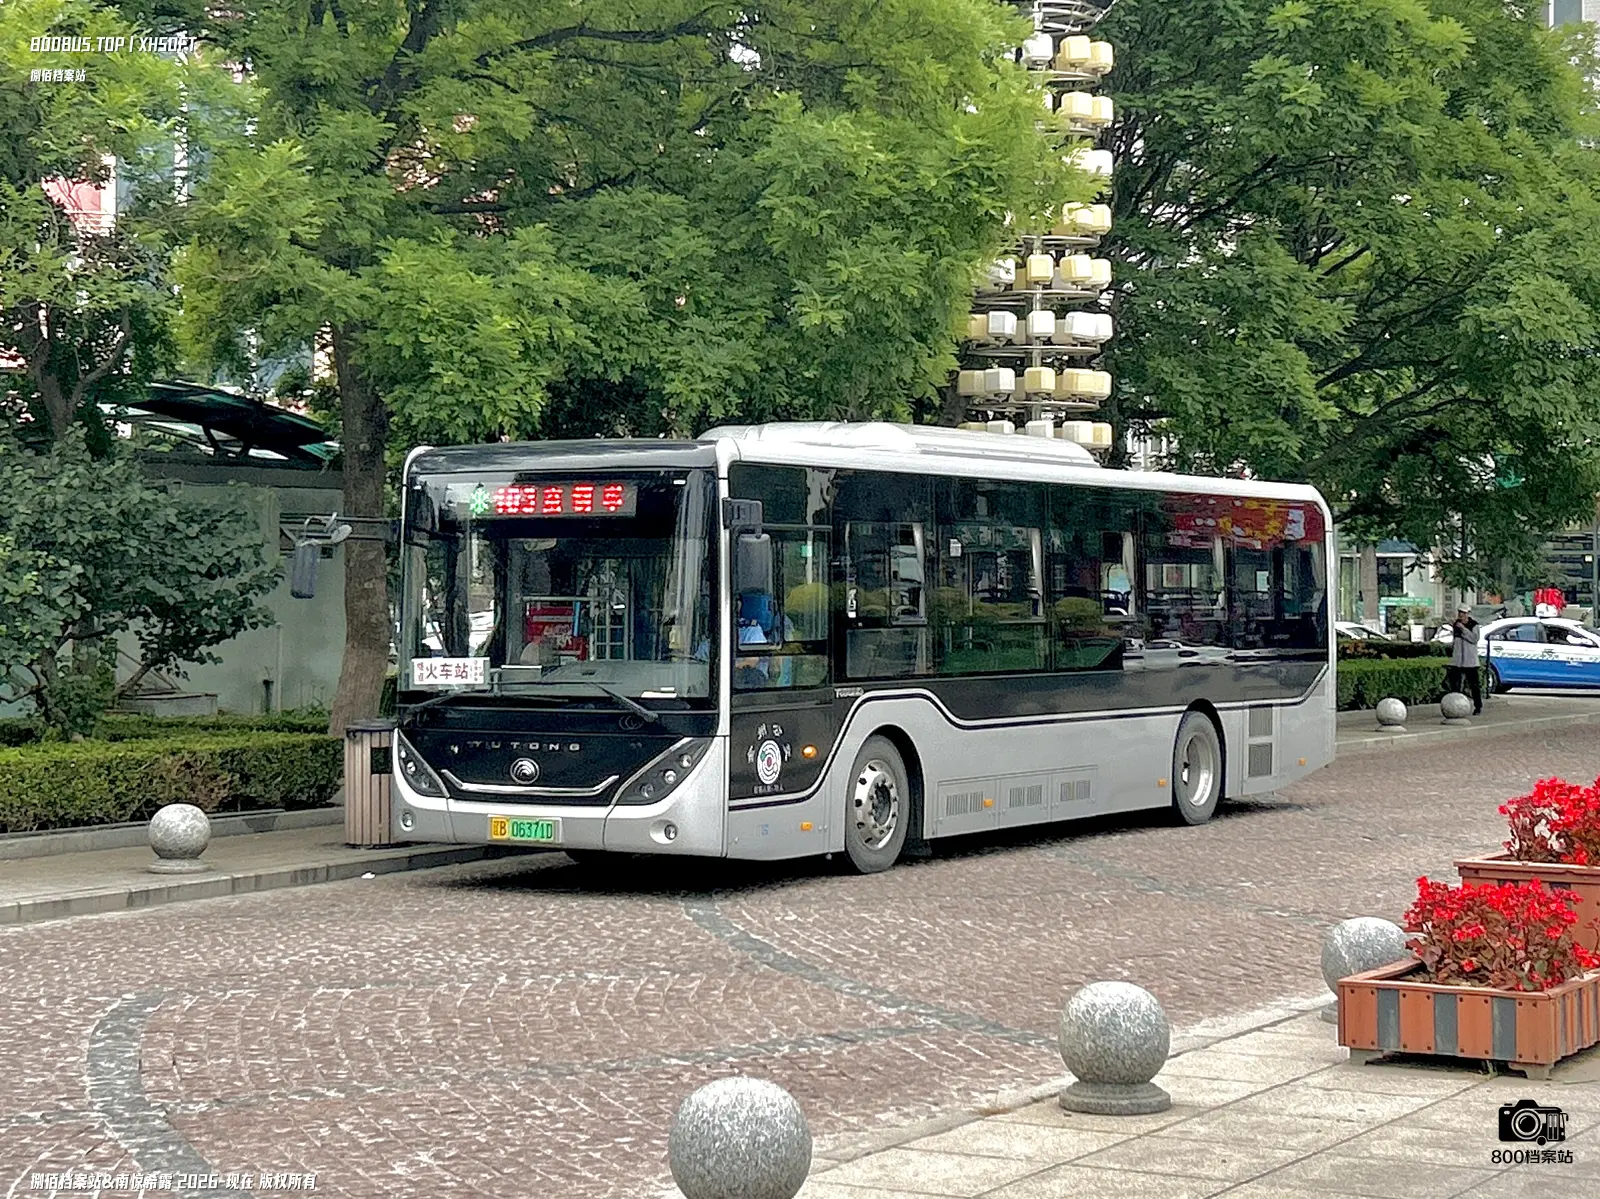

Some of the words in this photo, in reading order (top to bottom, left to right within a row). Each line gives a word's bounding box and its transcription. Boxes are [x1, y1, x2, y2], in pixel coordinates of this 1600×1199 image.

[425, 662, 469, 680] 火车站
[471, 740, 581, 752] YUTONG
